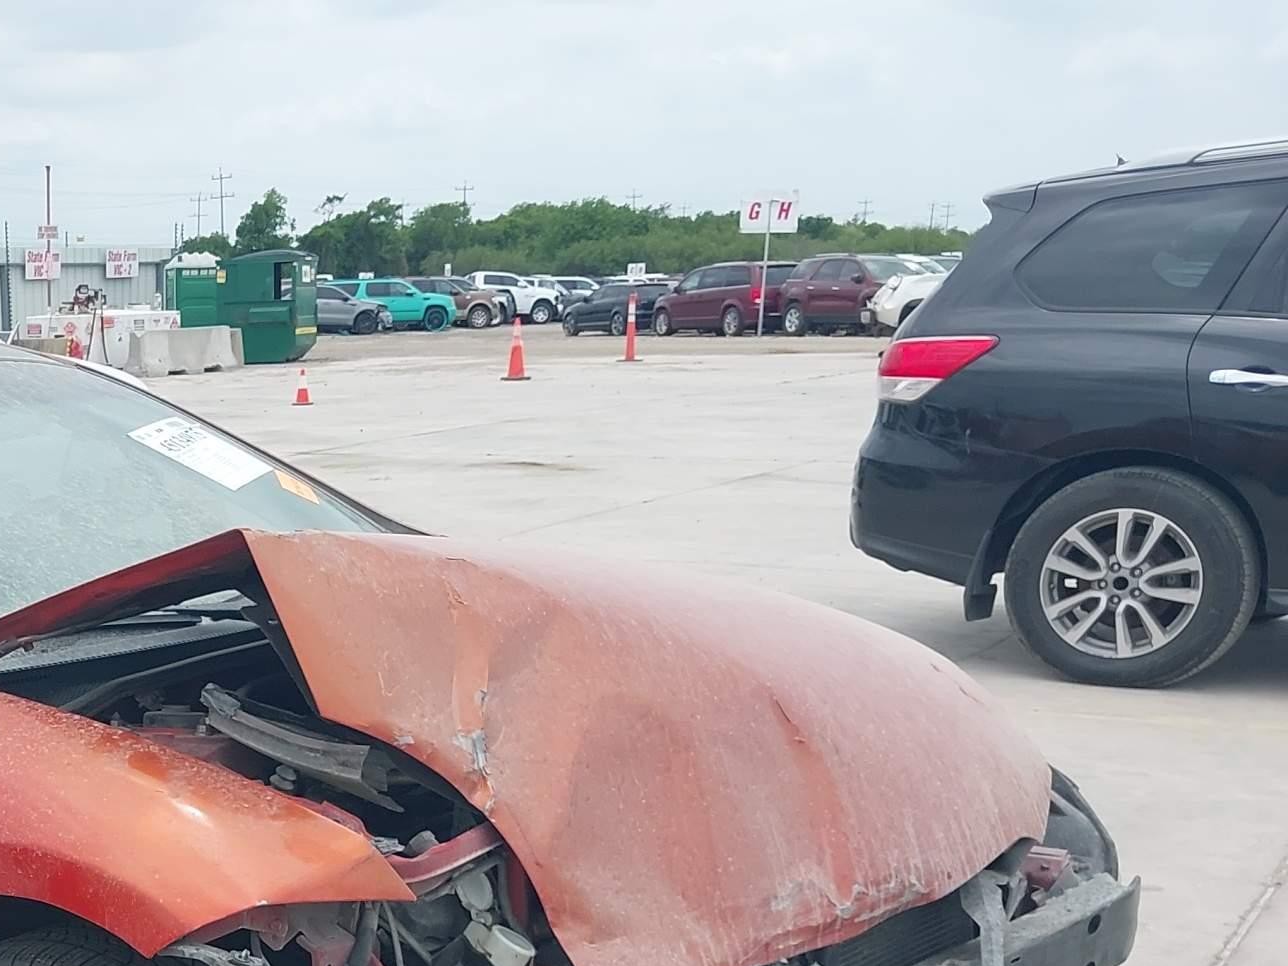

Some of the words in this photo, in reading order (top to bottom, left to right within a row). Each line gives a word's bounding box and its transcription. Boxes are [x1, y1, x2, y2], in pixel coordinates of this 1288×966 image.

[748, 201, 762, 221] G
[777, 201, 793, 221] H
[107, 250, 122, 262] State
[123, 250, 137, 262] Farm
